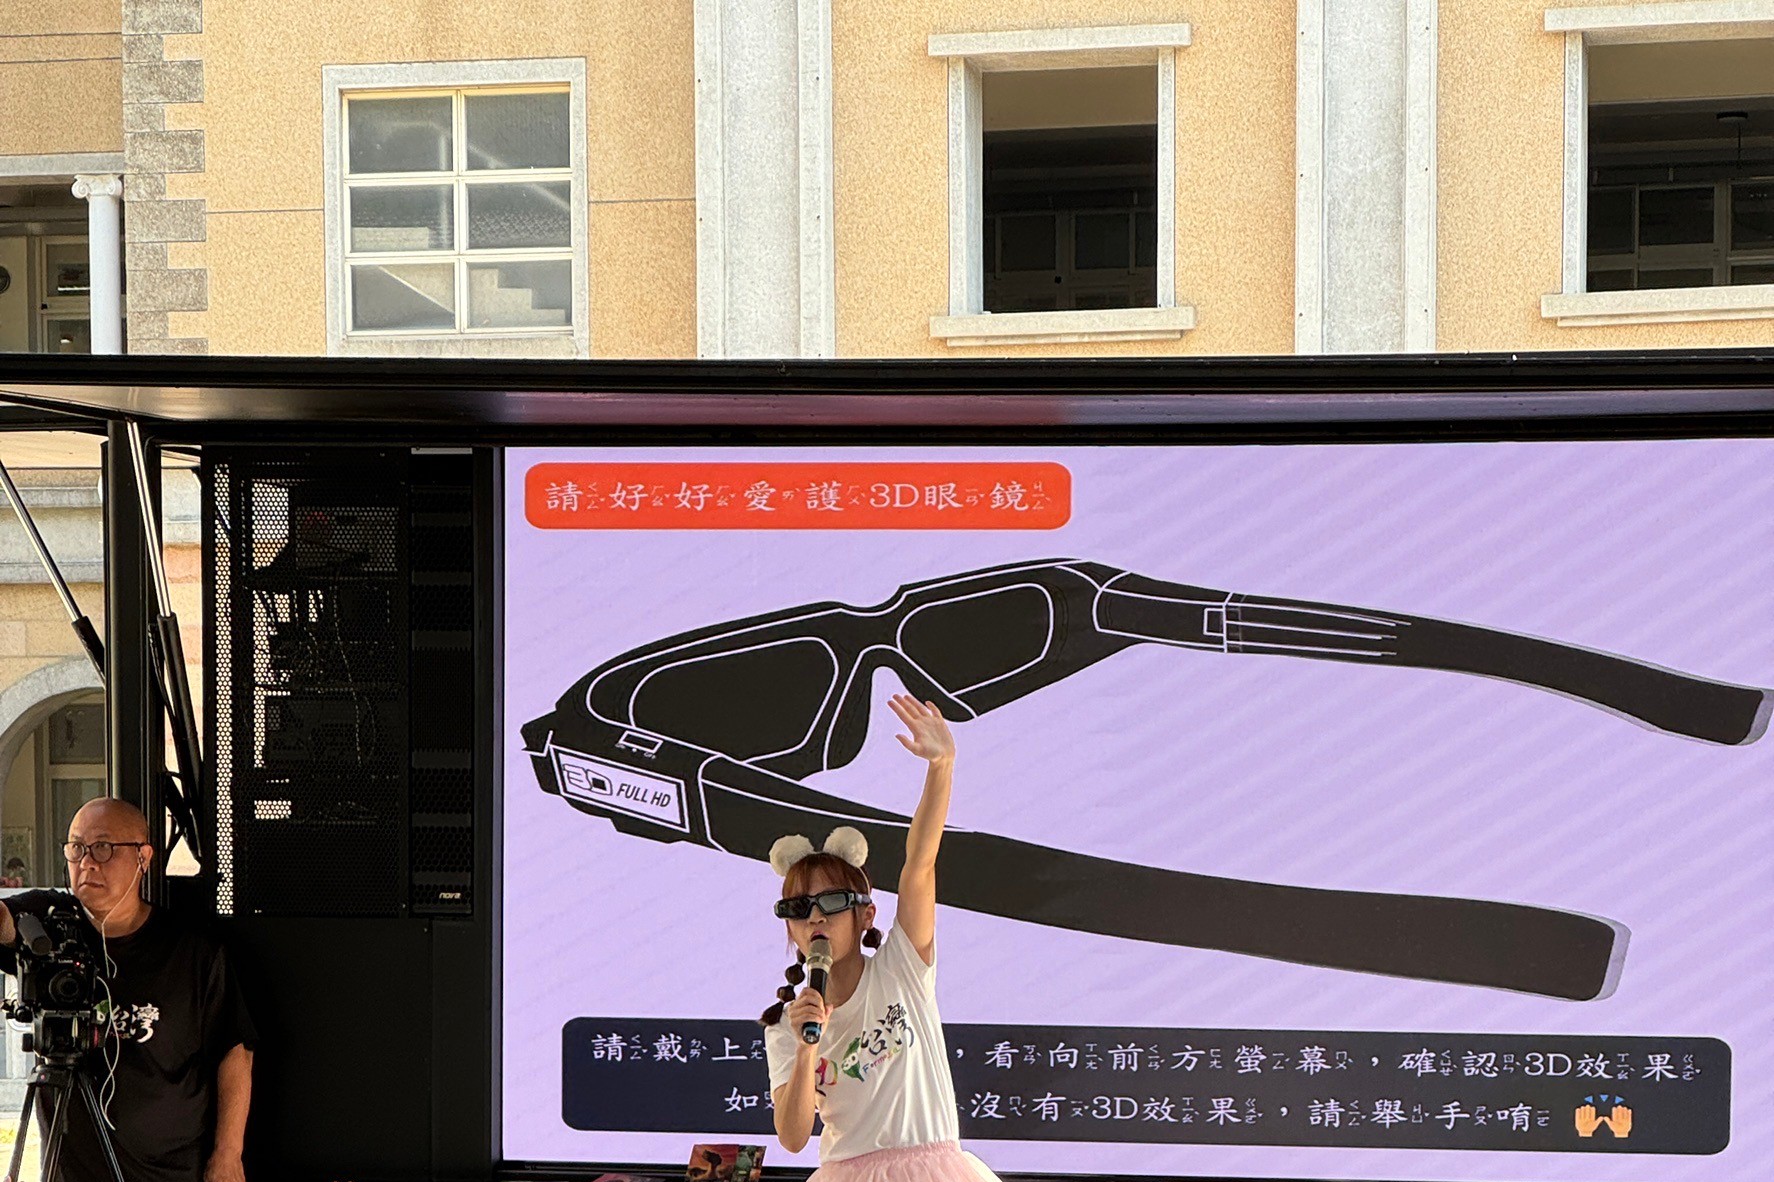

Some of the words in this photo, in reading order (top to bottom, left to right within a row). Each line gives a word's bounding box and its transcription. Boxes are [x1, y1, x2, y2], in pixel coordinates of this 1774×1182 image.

[544, 481, 1030, 513] 請好好愛護3D眼鏡
[616, 783, 648, 803] FULL
[650, 790, 671, 808] HD
[860, 1002, 915, 1056] 台灣
